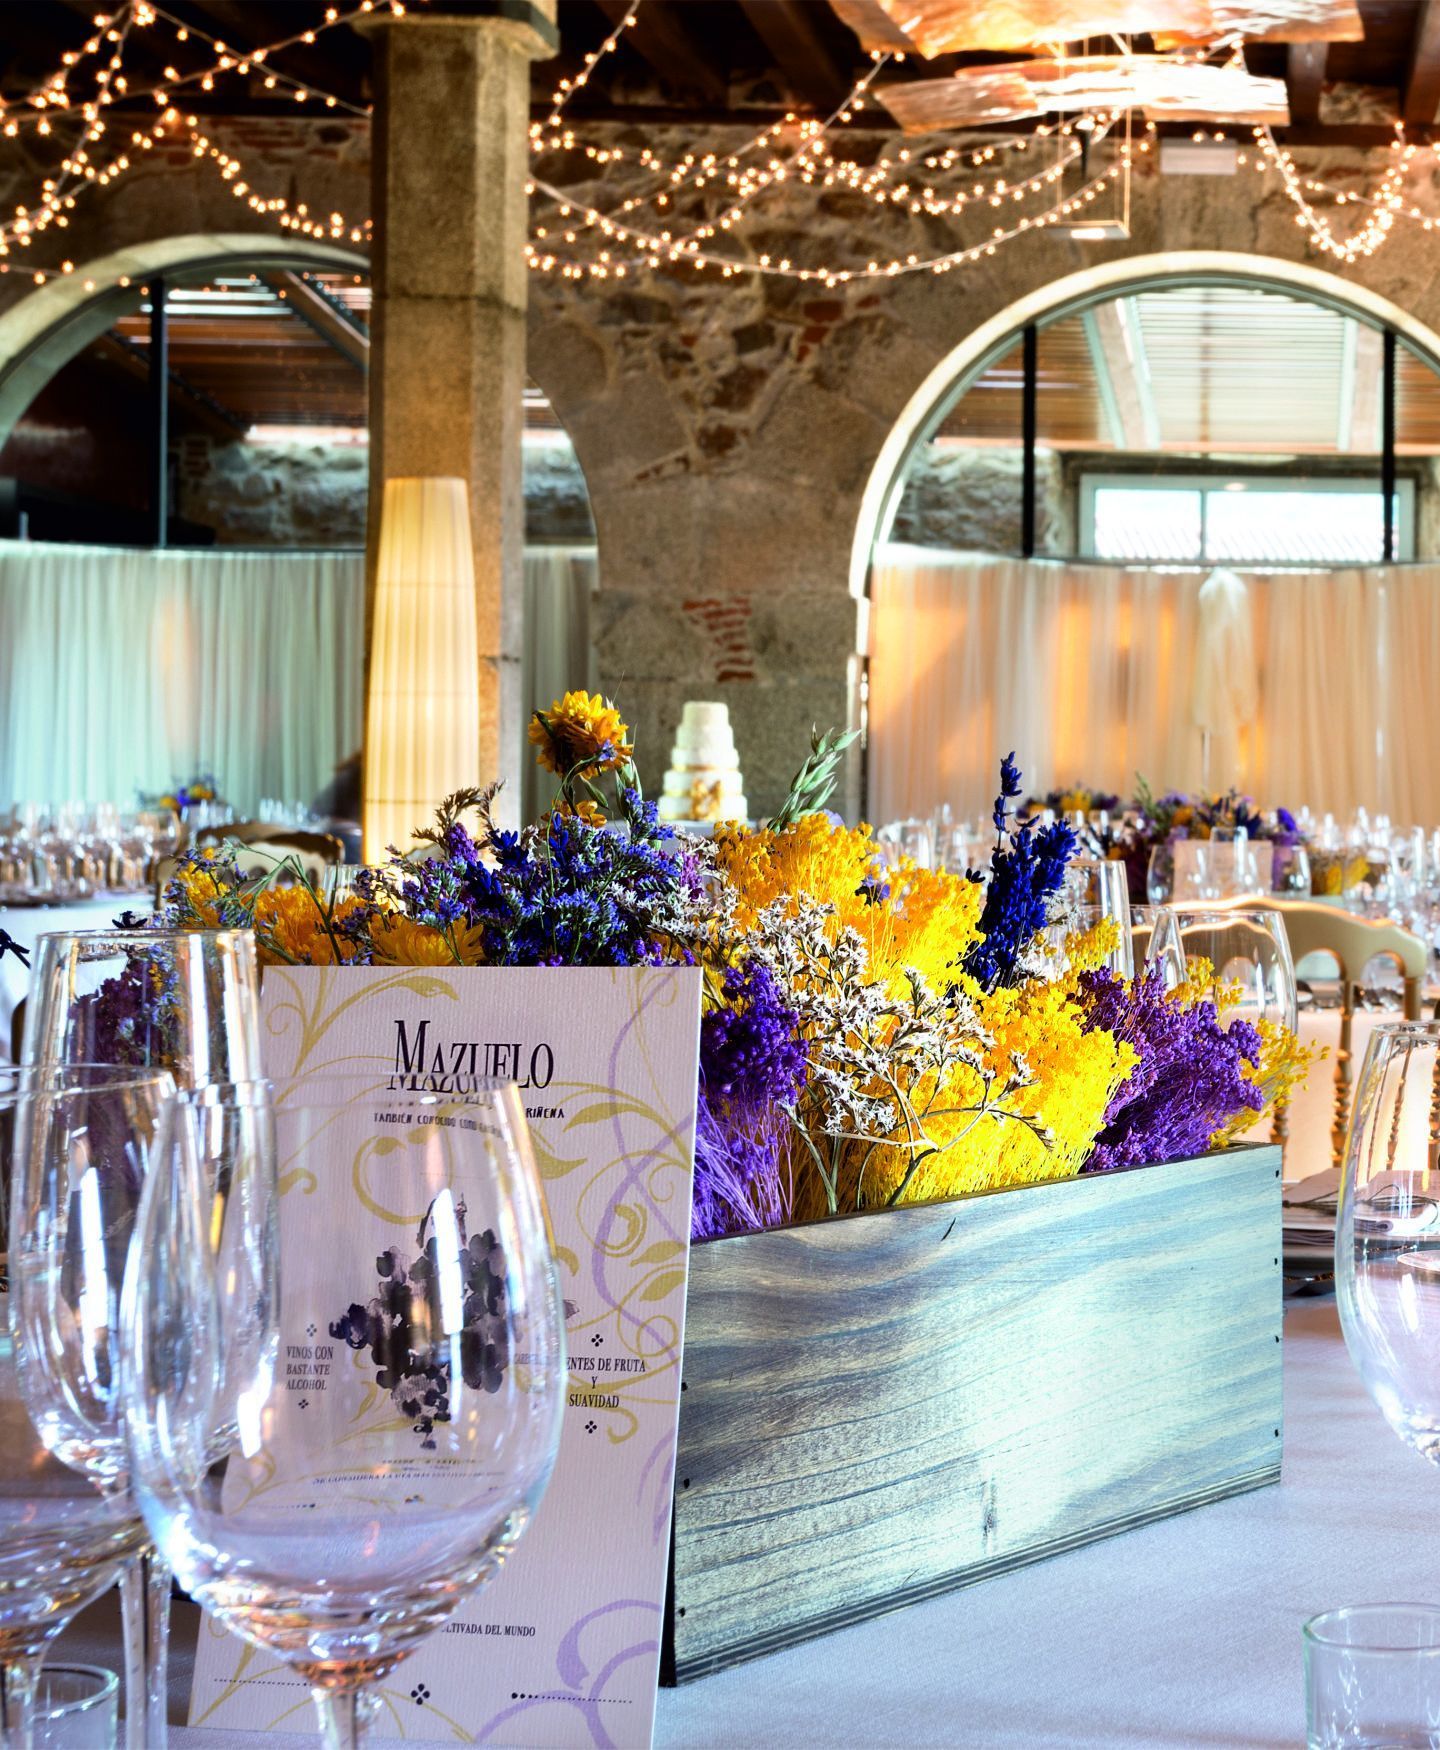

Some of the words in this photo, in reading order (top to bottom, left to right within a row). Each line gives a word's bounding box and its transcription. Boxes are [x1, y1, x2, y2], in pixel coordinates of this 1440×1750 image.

[388, 1020, 554, 1093] MAZUELO
[526, 1106, 564, 1119] RIÑENA
[286, 1345, 312, 1359] VINOS
[315, 1346, 334, 1360] CON
[286, 1363, 331, 1375] BASTANTE
[566, 1356, 595, 1371] ENTES
[597, 1357, 612, 1372] DE
[614, 1358, 646, 1373] FRUTA
[286, 1379, 327, 1391] ALCOHOL
[591, 1375, 598, 1390] Y
[569, 1392, 620, 1408] SUAVIDAD
[442, 1622, 482, 1635] LTIVADA
[485, 1624, 502, 1636] DEL
[504, 1625, 536, 1637] MUNDO
